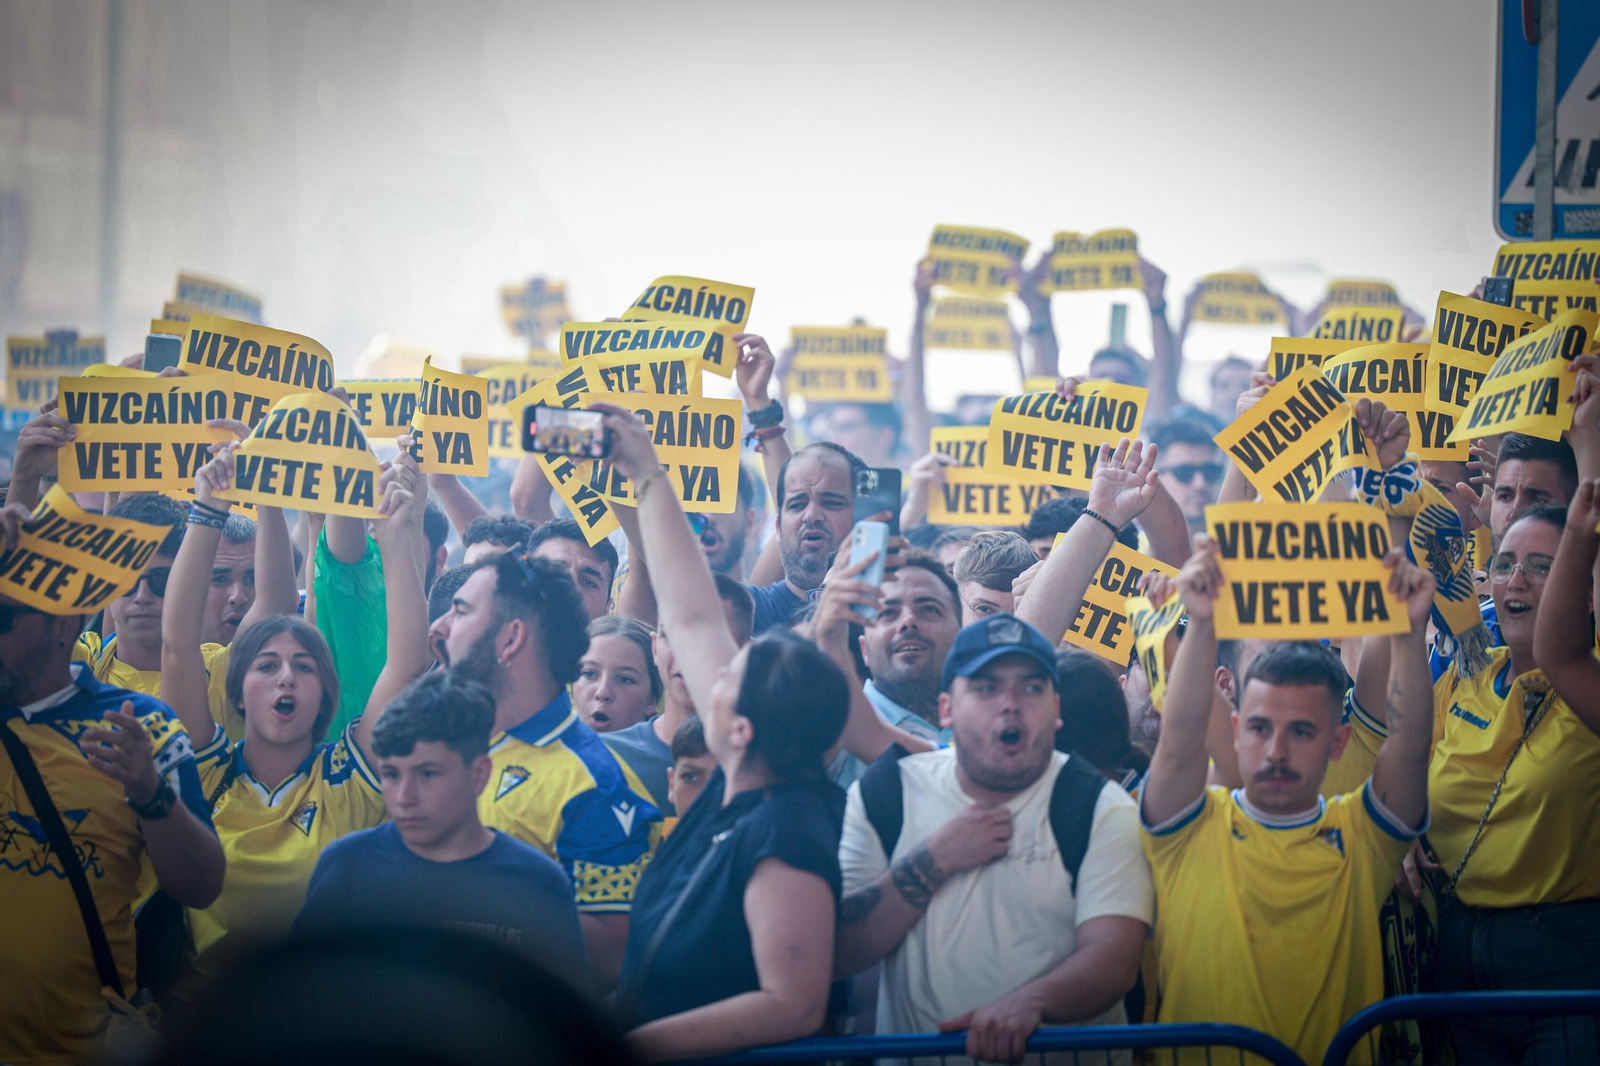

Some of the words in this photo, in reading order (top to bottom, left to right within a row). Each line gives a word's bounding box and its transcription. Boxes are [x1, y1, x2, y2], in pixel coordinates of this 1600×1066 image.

[630, 285, 746, 324] ZCAÍNO
[1514, 295, 1559, 323] ETE
[565, 326, 705, 360] VIZCAÍNO
[703, 332, 724, 365] A
[1315, 313, 1393, 342] CAÍNO
[187, 329, 333, 393] VIZCAÍNO
[599, 364, 641, 393] ETE
[649, 360, 688, 394] YA
[1325, 352, 1427, 393] VIZCAÍ
[64, 386, 227, 425] VIZCAÍNO
[419, 377, 482, 420] AÍNO
[1439, 362, 1487, 408] VET
[1466, 384, 1527, 430] VETE
[1524, 377, 1560, 416] YA
[231, 391, 271, 430] TE
[381, 393, 419, 426] YA
[633, 405, 735, 450] CAÍNO
[1001, 390, 1139, 434] VIZCAÍNO
[1229, 377, 1346, 474] VIZCAÍN
[1416, 411, 1457, 449] YA
[75, 442, 163, 480] VETE
[432, 432, 474, 466] YA
[1003, 430, 1075, 476] VETE
[1273, 438, 1334, 503] VETE
[1338, 416, 1370, 458] YA
[236, 454, 323, 500] VETE
[332, 465, 374, 508] YA
[679, 465, 720, 502] YA
[943, 483, 1011, 515] VETE
[571, 484, 609, 528] YA
[21, 502, 158, 571] VIZCAÍNO
[1214, 513, 1389, 560] VIZCAÍNO
[0, 547, 79, 602] VETE
[71, 572, 118, 608] YA
[1230, 580, 1329, 625] VETE
[1336, 580, 1390, 623] YA
[1068, 600, 1128, 650] ETE
